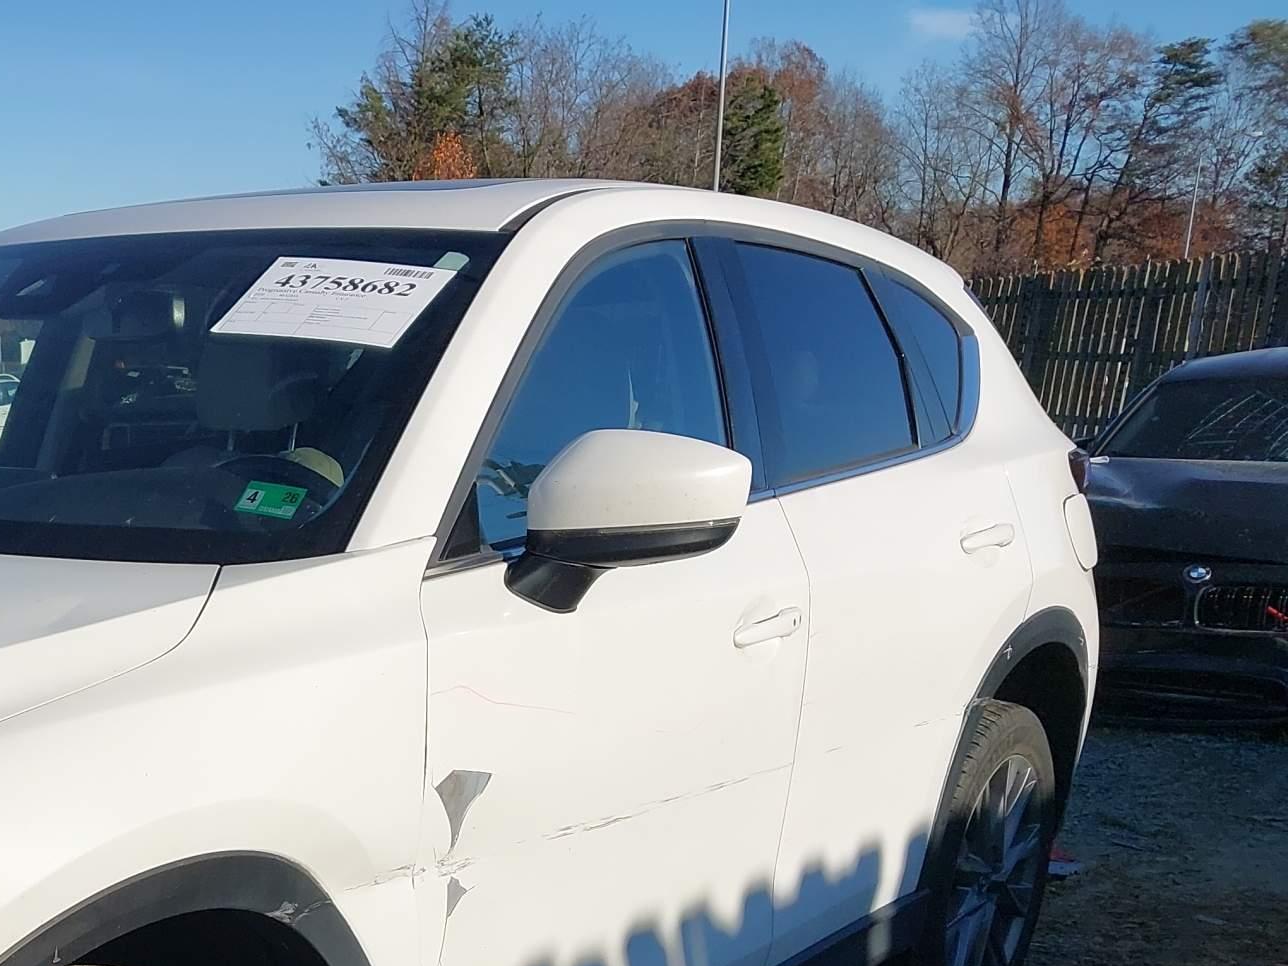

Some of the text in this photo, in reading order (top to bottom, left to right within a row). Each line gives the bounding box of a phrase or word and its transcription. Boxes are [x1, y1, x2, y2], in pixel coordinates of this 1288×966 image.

[275, 274, 418, 297] 43758682
[246, 490, 260, 504] 4
[282, 491, 300, 504] 26
